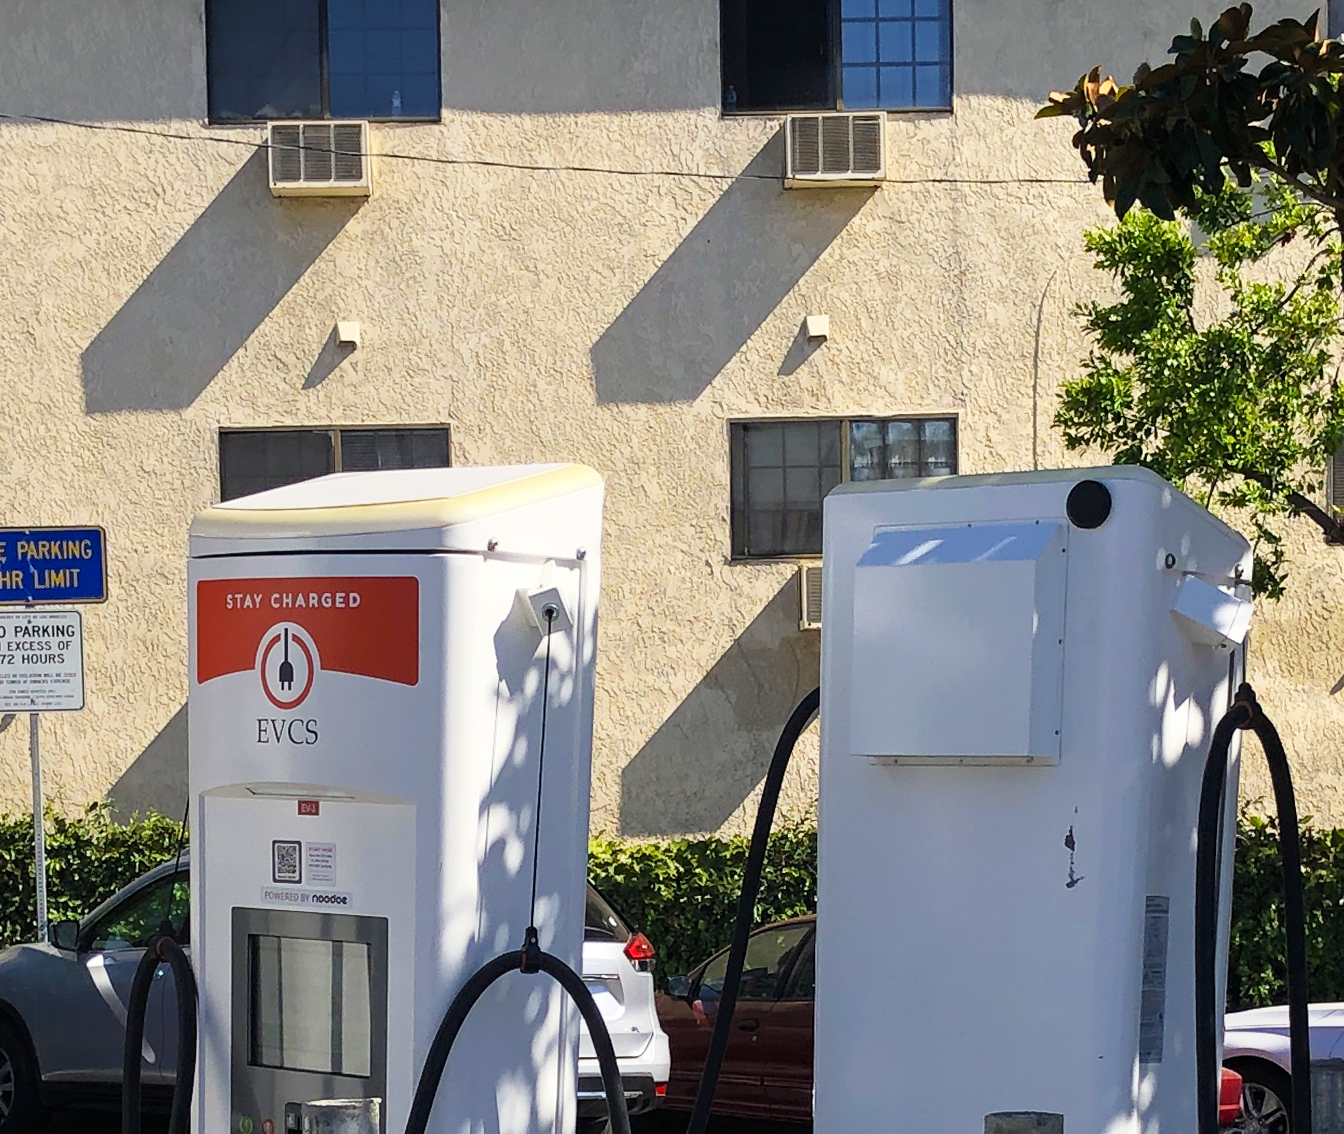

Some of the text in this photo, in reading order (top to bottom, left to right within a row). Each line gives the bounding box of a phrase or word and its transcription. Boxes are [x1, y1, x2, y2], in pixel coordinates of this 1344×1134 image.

[17, 539, 93, 561] PARKING
[33, 568, 81, 590] LIMIT
[225, 591, 362, 610] STAY CHARGED
[14, 624, 76, 638] PARKING
[7, 640, 52, 651] EXCESS
[58, 640, 72, 651] OF
[0, 654, 65, 665] 72 HOURS
[256, 718, 319, 746] EVCS
[264, 890, 349, 905] POWERED BY noodoe
